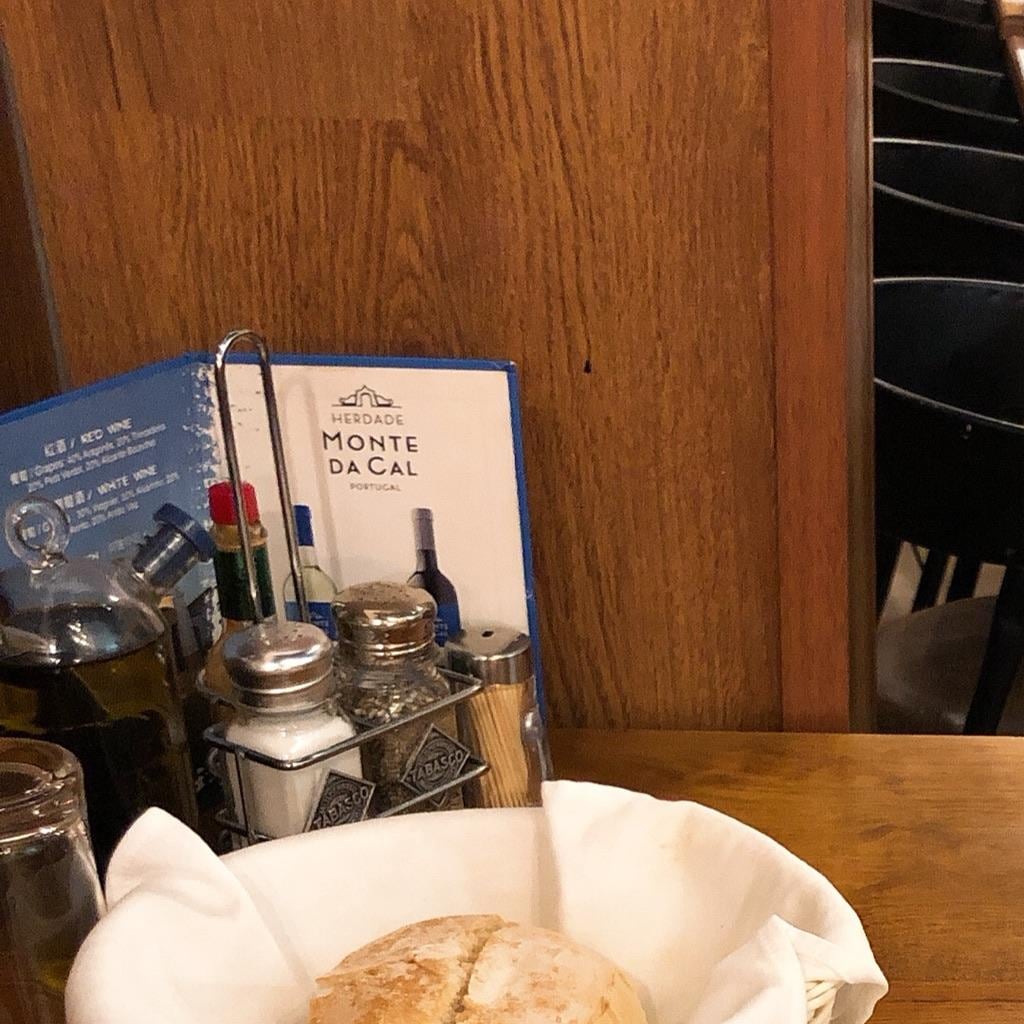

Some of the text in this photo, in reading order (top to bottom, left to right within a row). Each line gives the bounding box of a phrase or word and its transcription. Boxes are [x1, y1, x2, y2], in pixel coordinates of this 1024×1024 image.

[331, 413, 404, 425] HERDADE
[322, 430, 419, 453] MONTE
[329, 456, 418, 476] DA CAL
[350, 482, 402, 491] PORTUGAL
[411, 750, 464, 784] TABASCO
[313, 786, 370, 830] TABASCO
